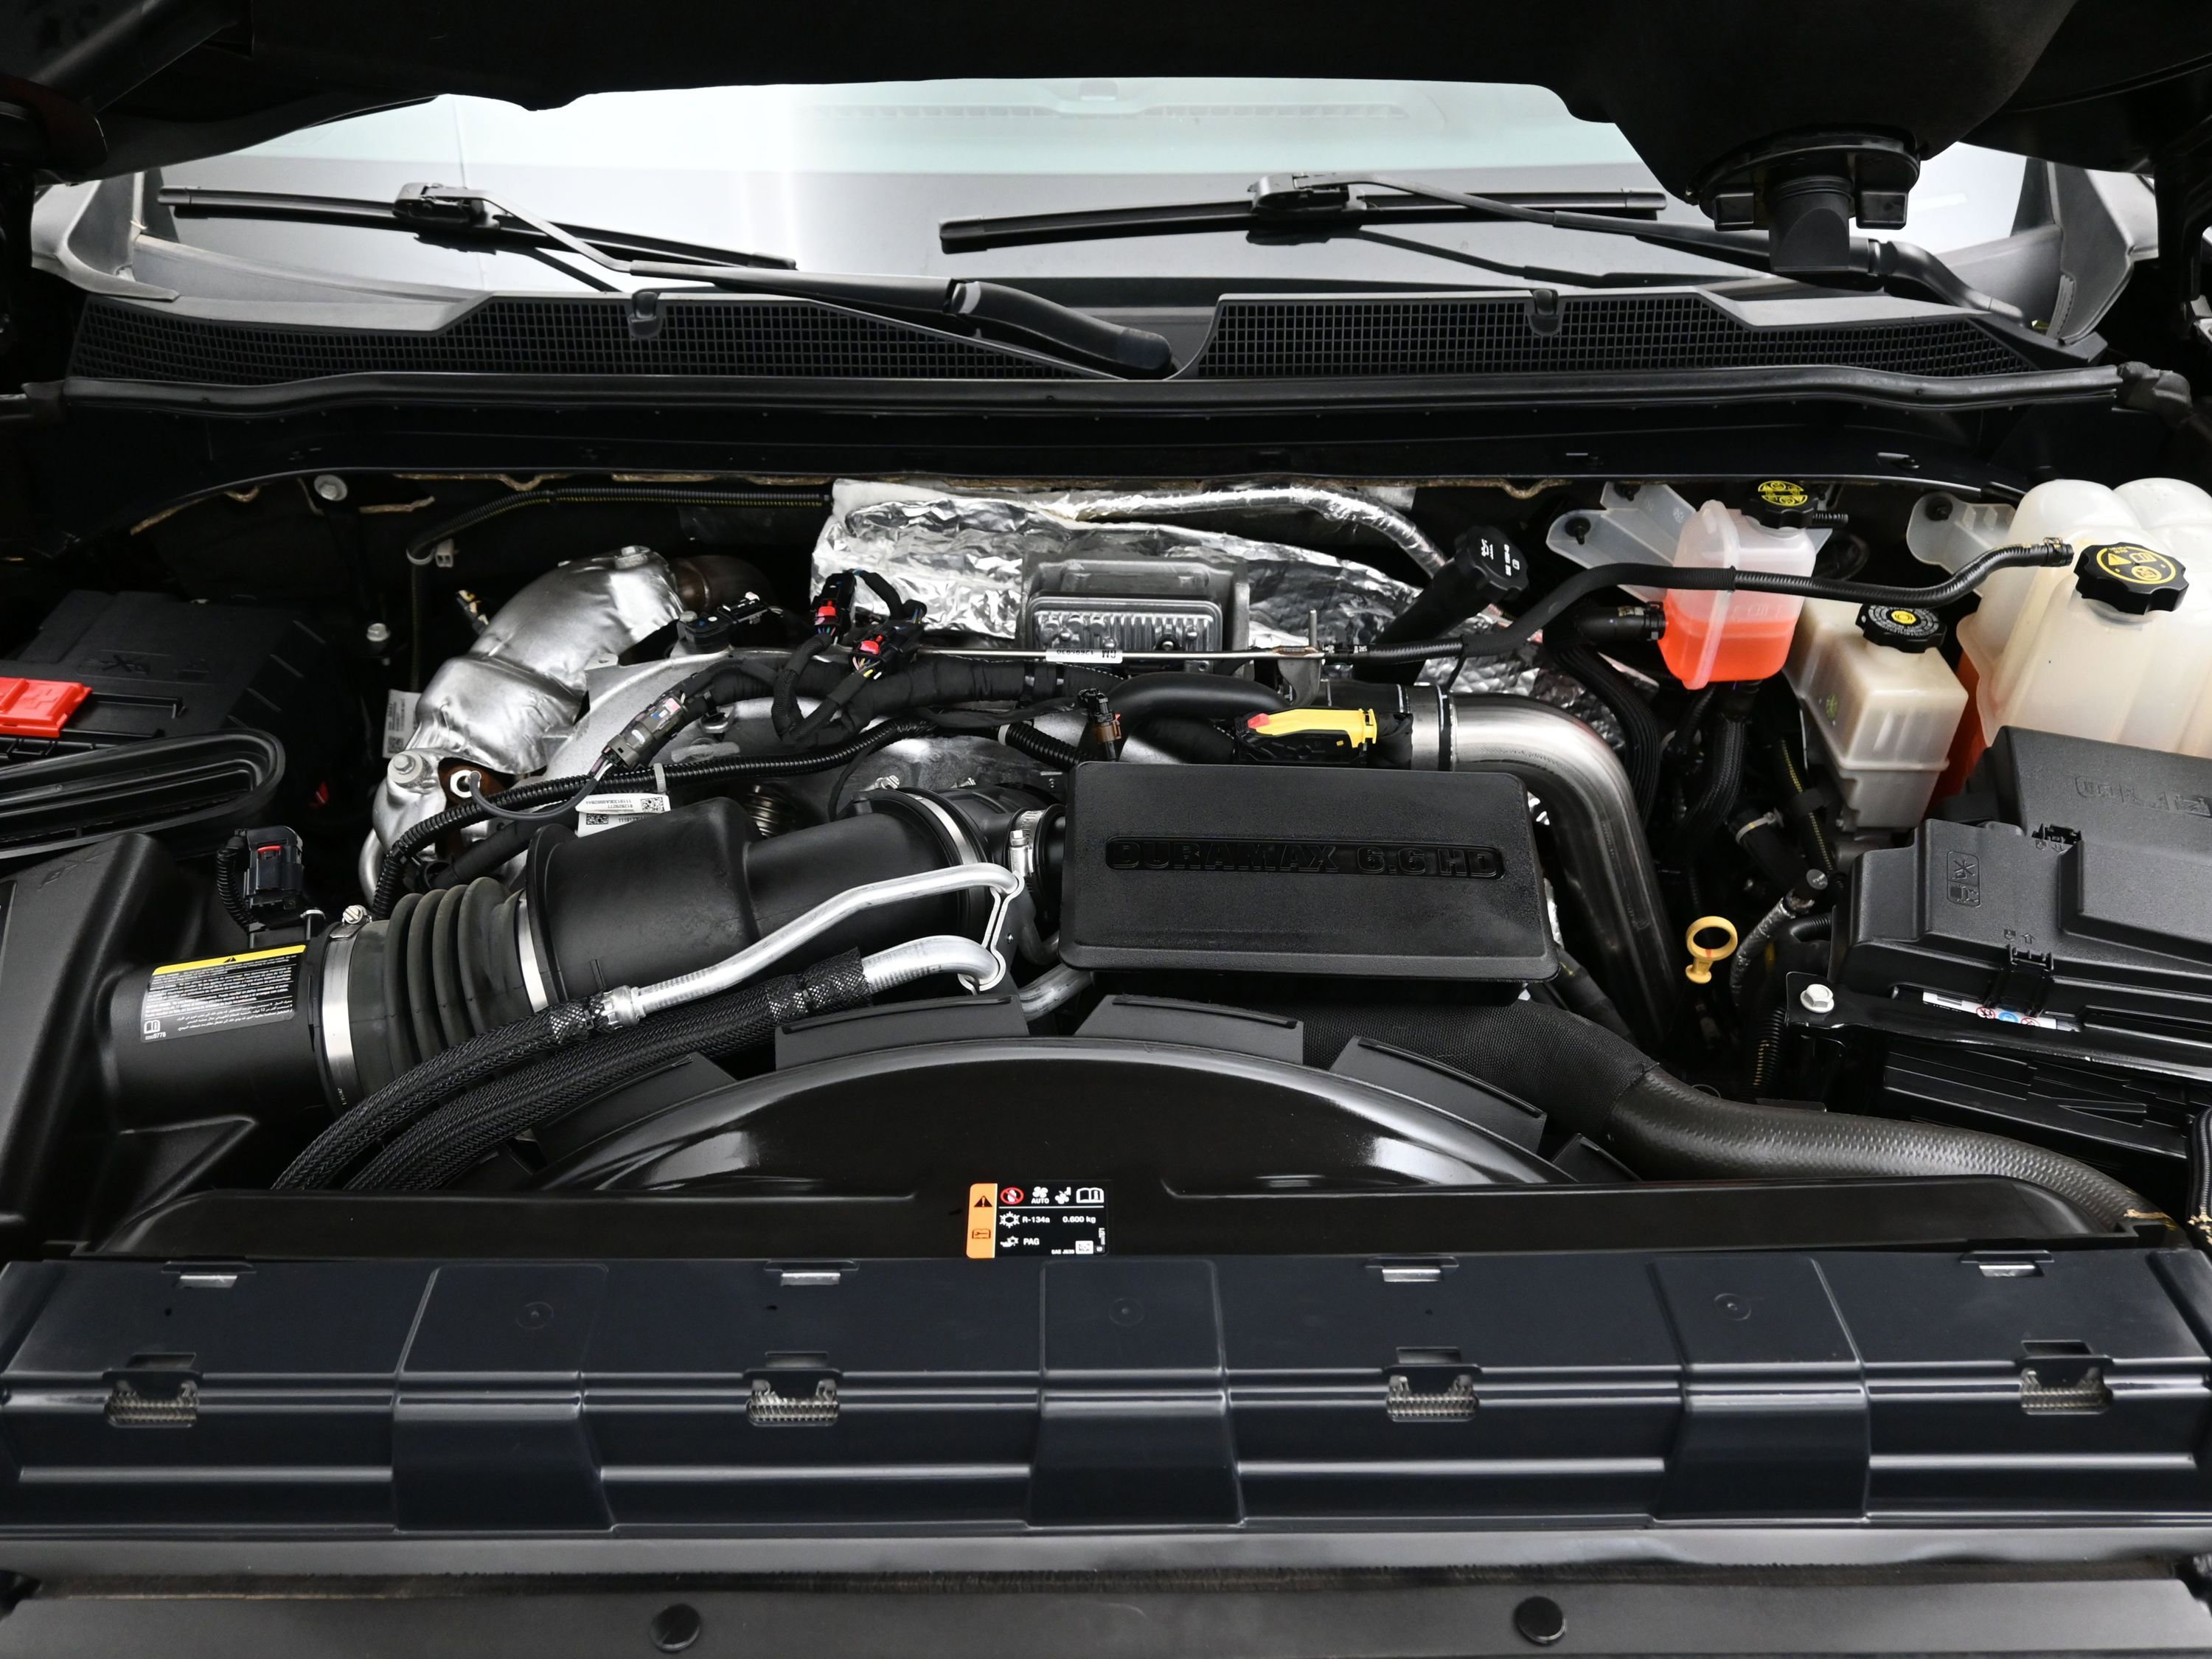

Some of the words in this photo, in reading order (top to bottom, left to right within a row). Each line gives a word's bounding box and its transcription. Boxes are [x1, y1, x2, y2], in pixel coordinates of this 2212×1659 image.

[1102, 649, 1116, 658] GM
[1113, 841, 1340, 872] DURAMAX
[1357, 846, 1427, 875] 6.6
[1439, 848, 1500, 878] HD
[1085, 1216, 1096, 1224] kg
[1023, 1237, 1040, 1245] PAG
